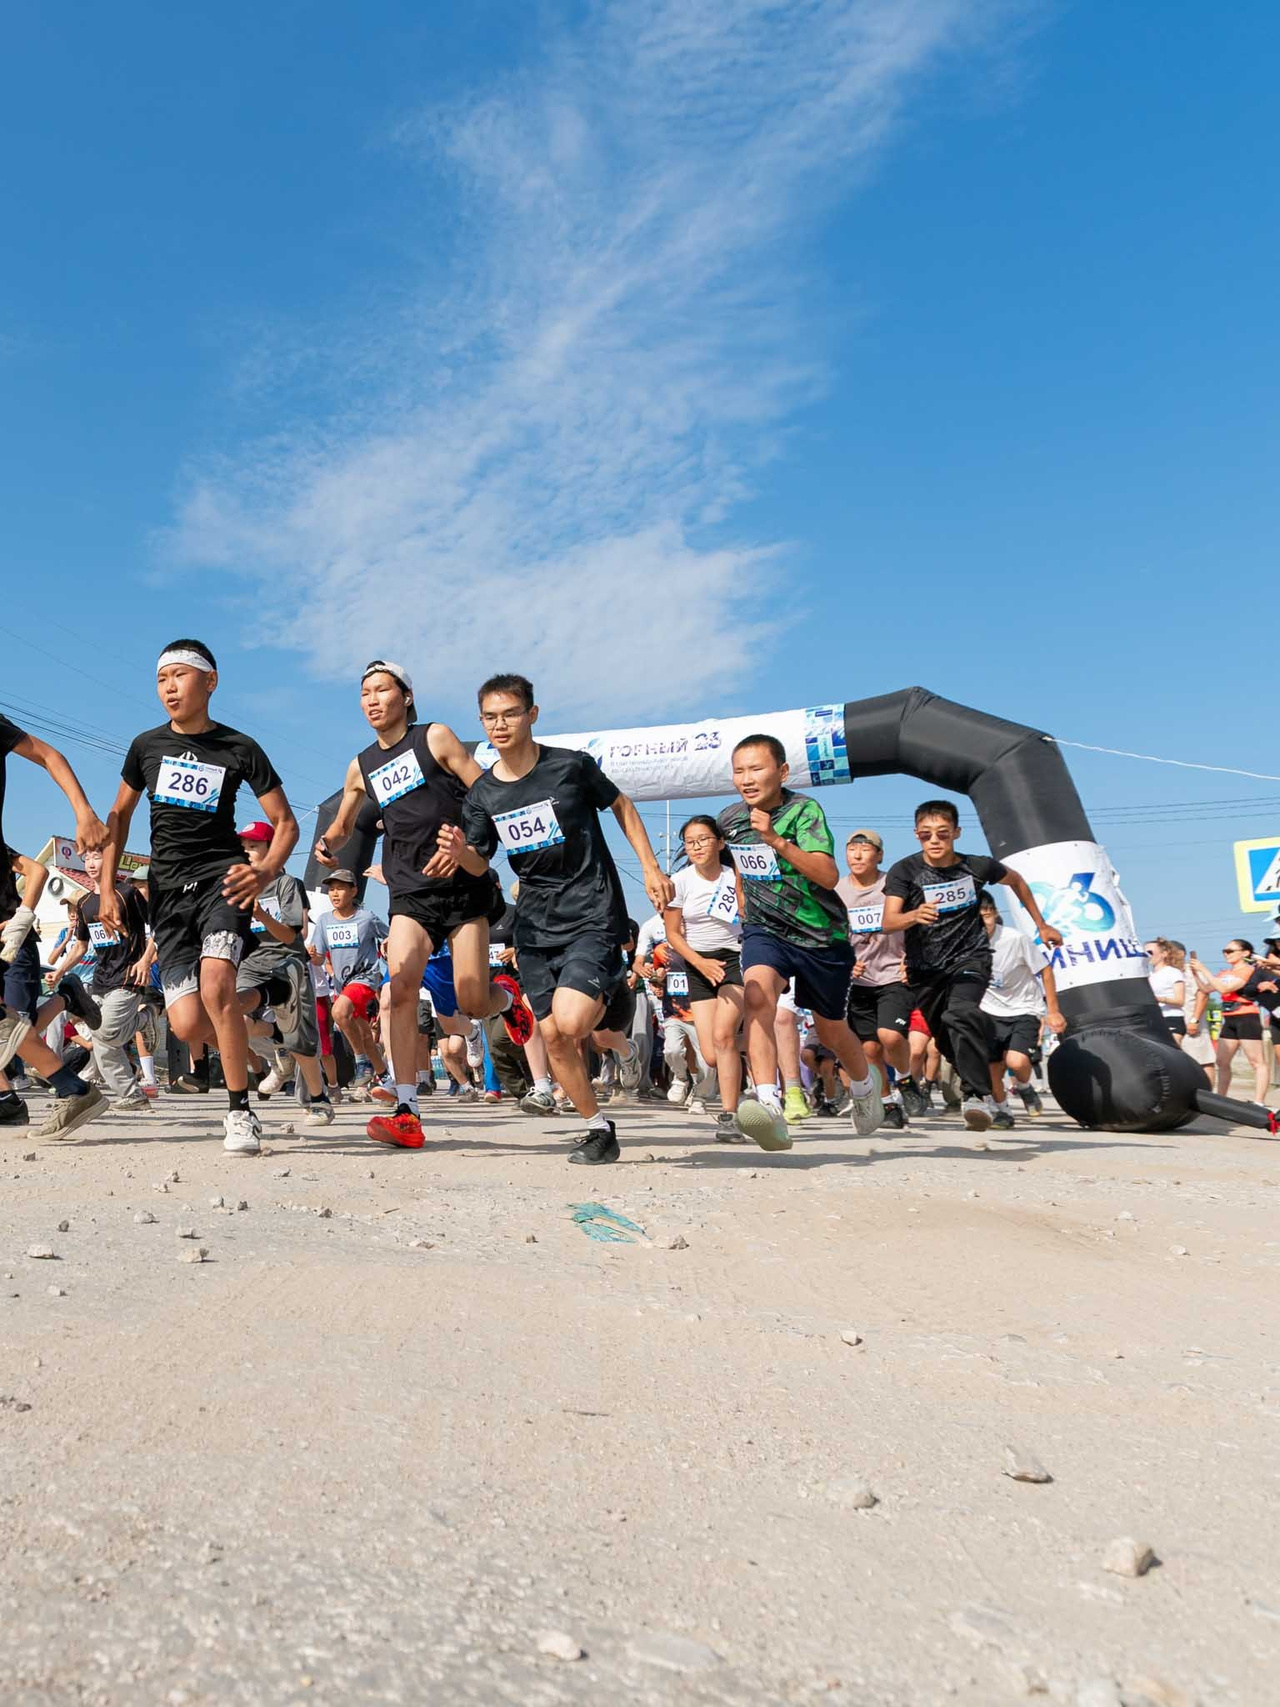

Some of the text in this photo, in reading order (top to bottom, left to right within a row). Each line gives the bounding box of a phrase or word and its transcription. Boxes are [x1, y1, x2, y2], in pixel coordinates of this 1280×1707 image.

[168, 772, 209, 796] 286
[382, 765, 412, 791] 042
[508, 816, 546, 841] 054
[740, 855, 767, 870] 066
[718, 885, 737, 913] 284
[935, 887, 966, 904] 285
[857, 912, 881, 925] 007
[332, 930, 352, 941] 003
[1035, 938, 1148, 979] ИНИШ
